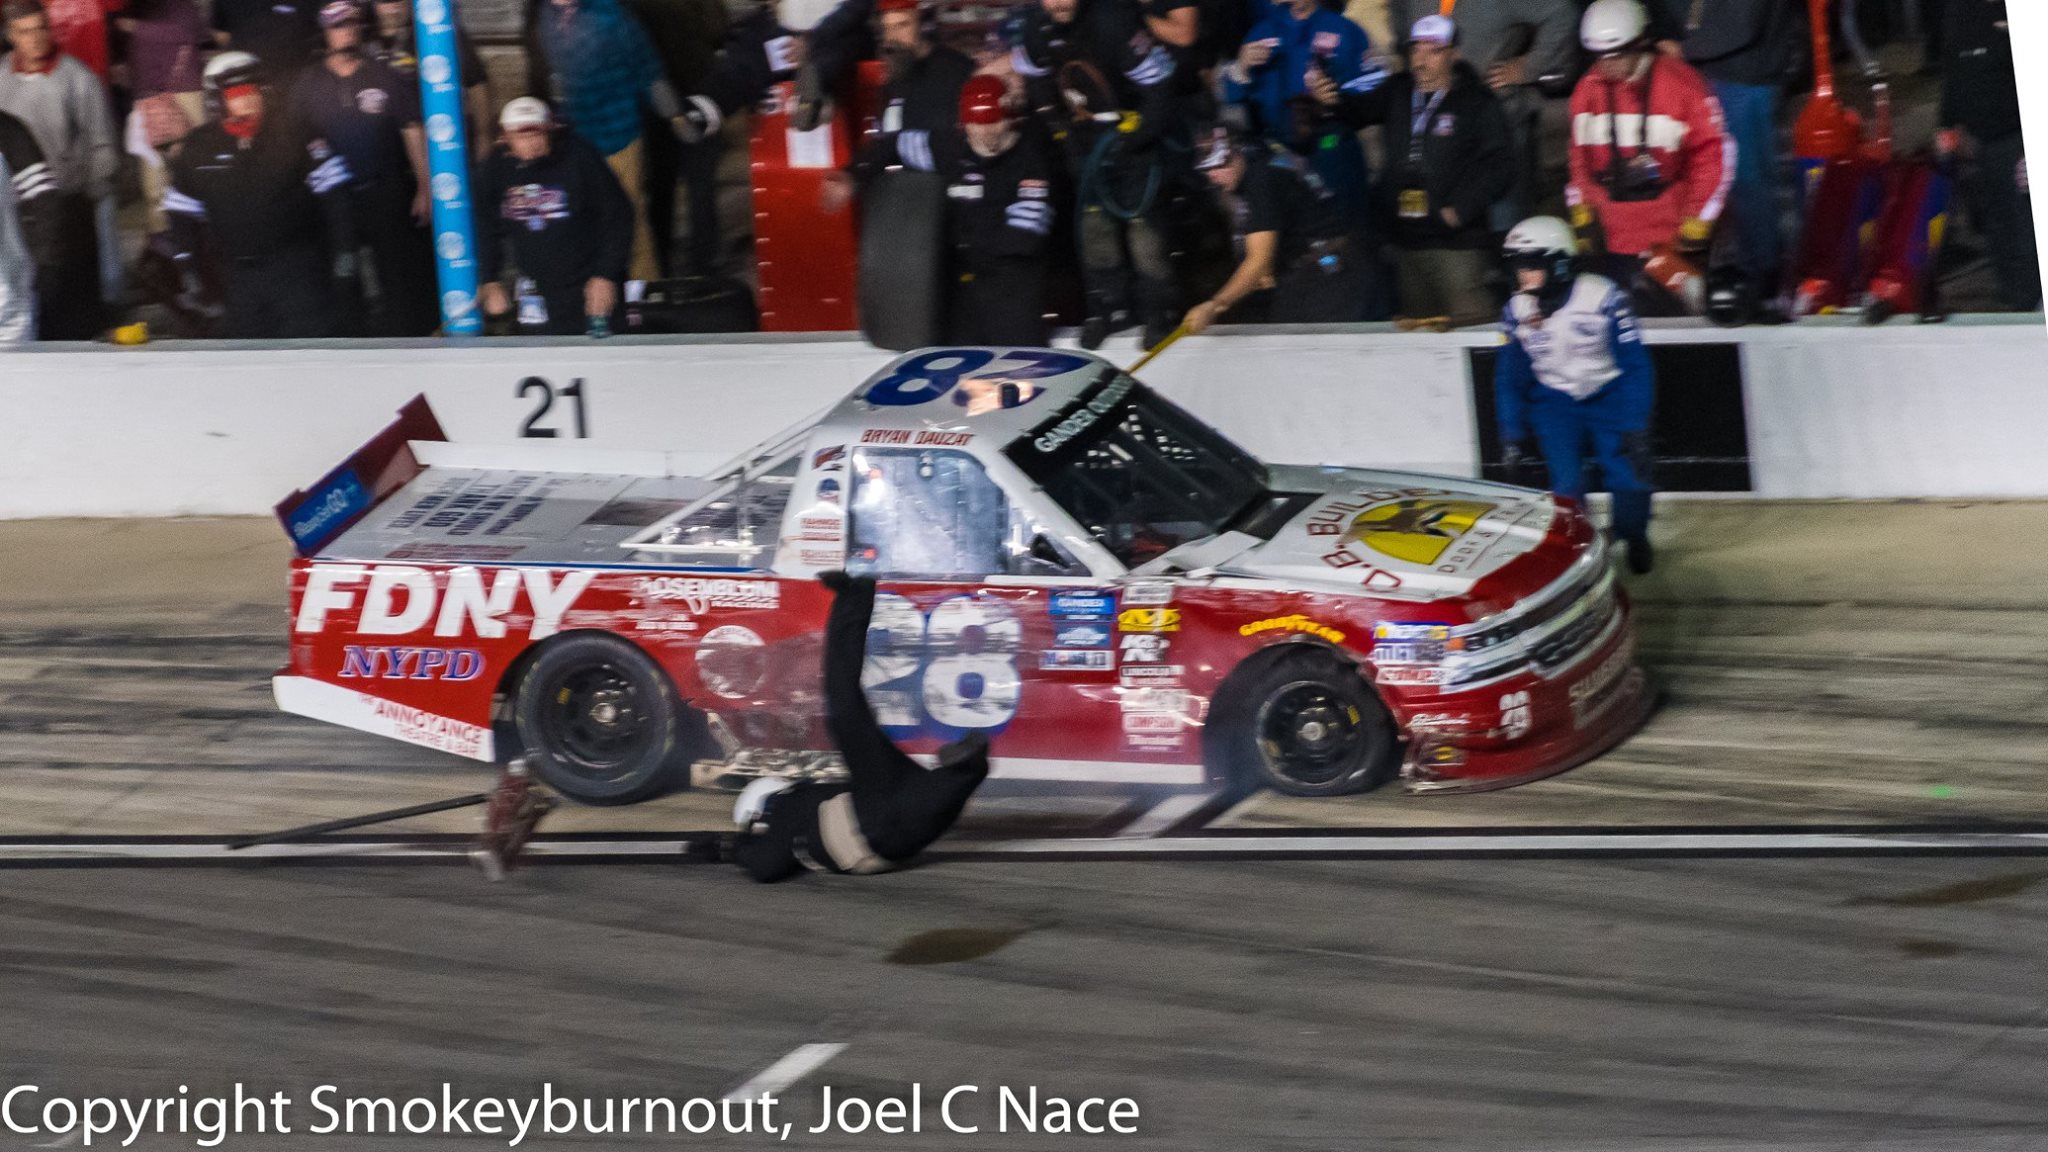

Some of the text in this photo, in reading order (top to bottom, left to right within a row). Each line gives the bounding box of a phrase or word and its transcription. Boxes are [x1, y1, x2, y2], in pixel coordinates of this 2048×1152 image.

[516, 376, 591, 439] 21
[860, 429, 976, 446] BRYAN DAUZAT
[295, 562, 597, 641] FDNY
[1239, 614, 1346, 644] GOODYEAR
[338, 644, 487, 682] NYPD
[861, 592, 1022, 736] 28
[374, 703, 482, 744] ANNOYANCE
